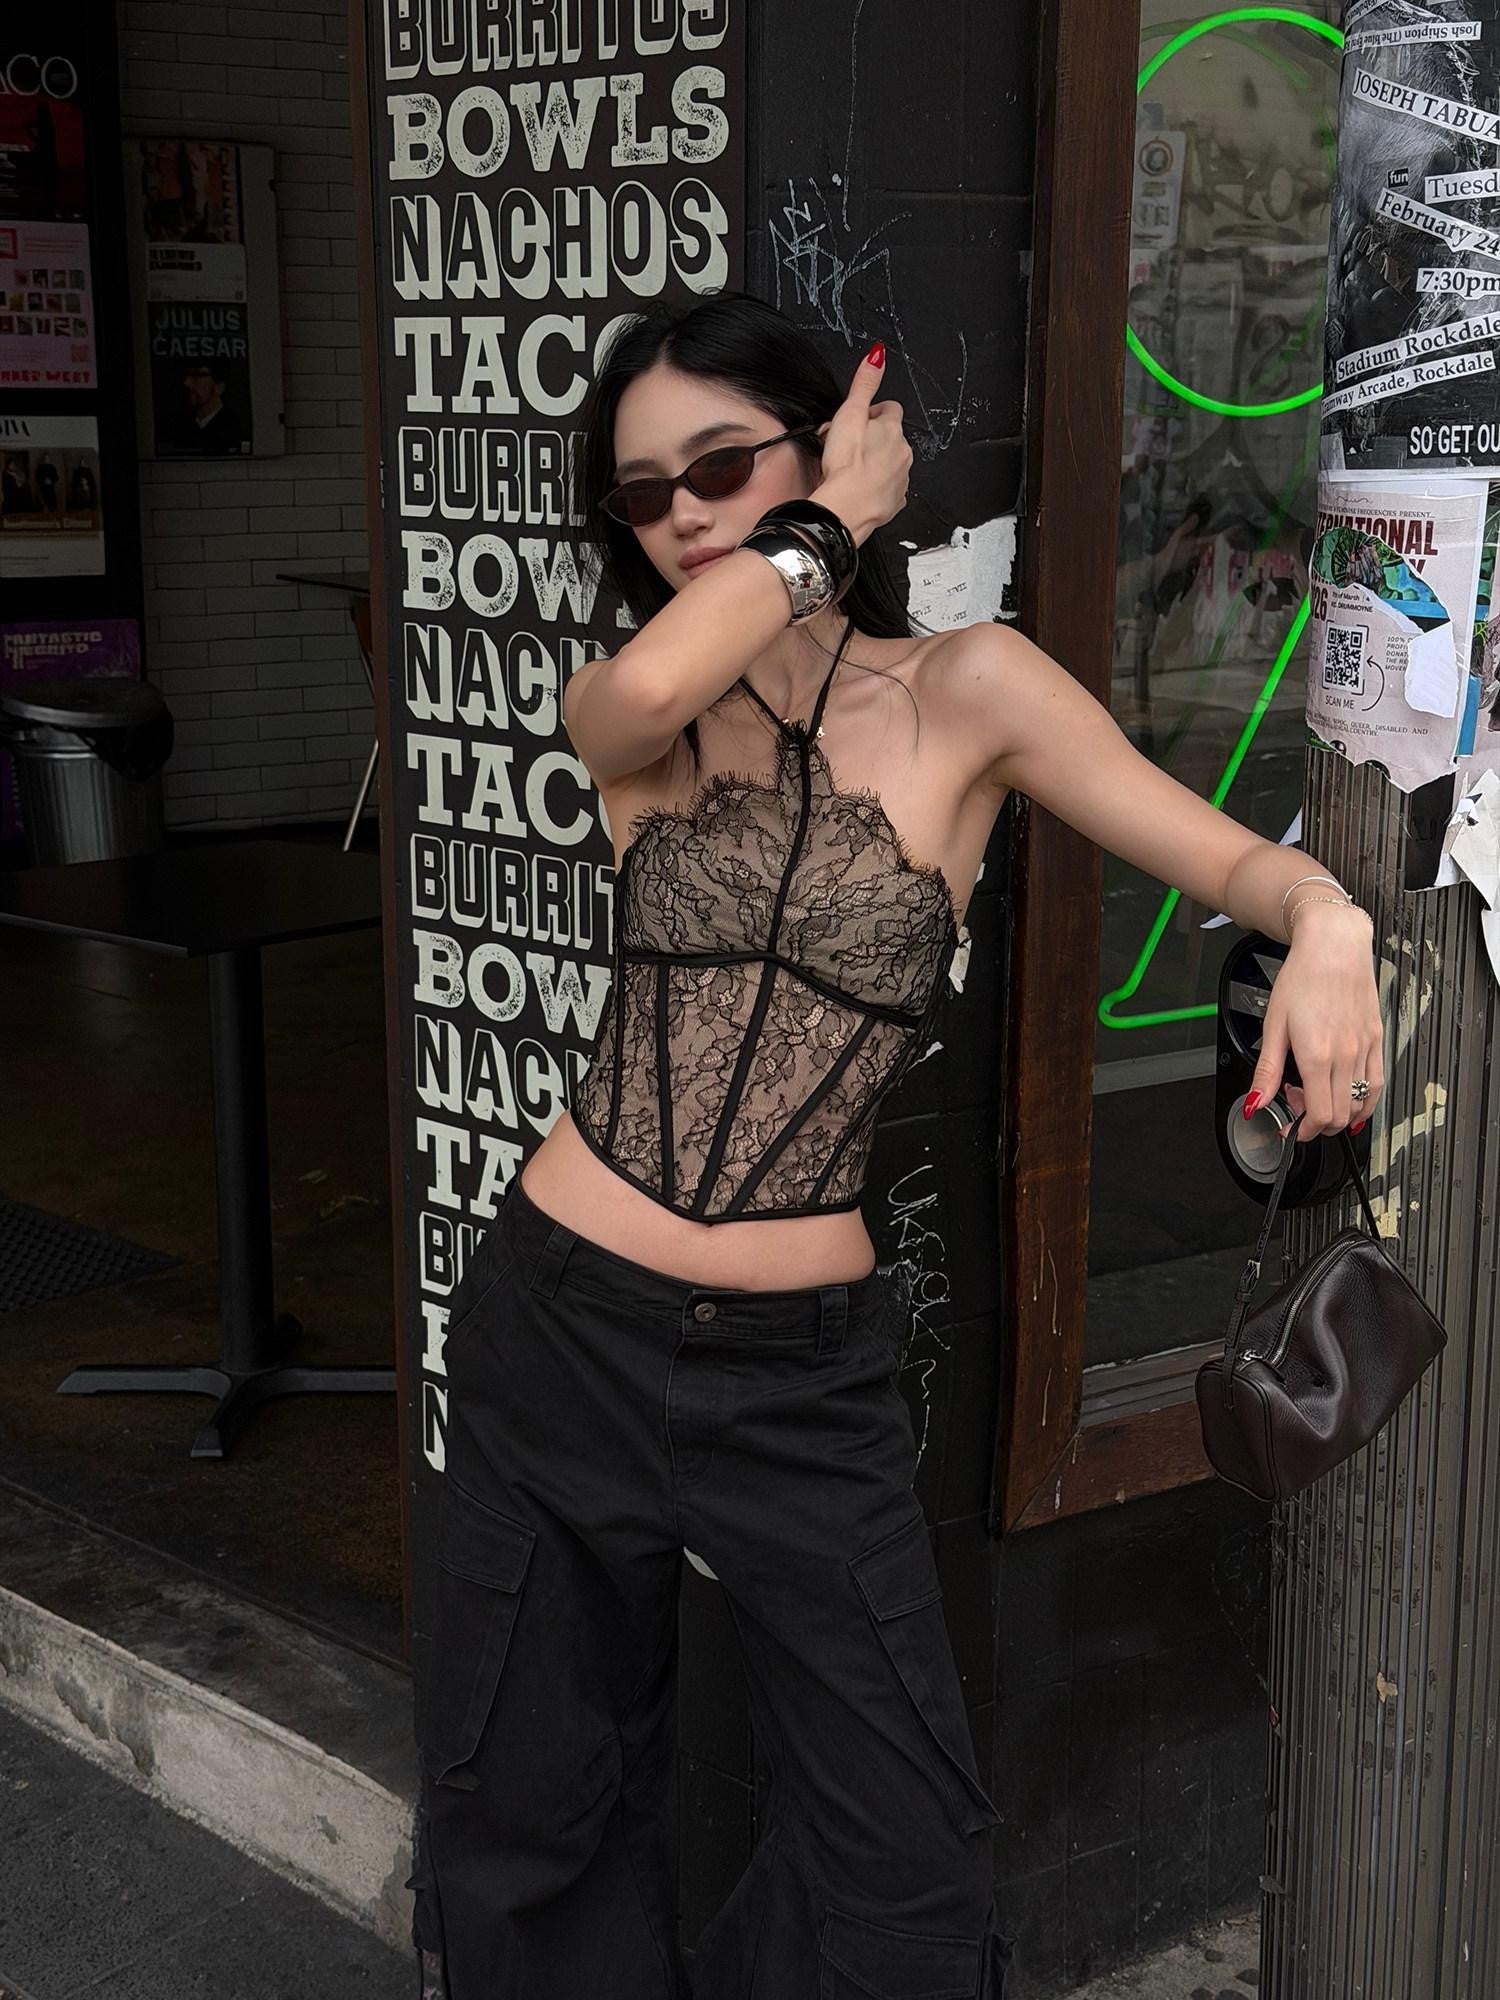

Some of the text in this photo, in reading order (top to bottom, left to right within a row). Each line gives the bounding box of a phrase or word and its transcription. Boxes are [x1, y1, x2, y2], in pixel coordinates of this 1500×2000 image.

[1405, 25, 1448, 41] Shipton
[1451, 24, 1479, 38] Josh
[0, 54, 78, 98] CO
[386, 65, 729, 180] BOWLS
[1354, 71, 1500, 139] JOSEPH TABUA
[1390, 171, 1409, 185] fun
[1428, 172, 1499, 198] Tuesd
[390, 177, 729, 301] NACHOS
[1379, 194, 1500, 256] February 24
[1422, 271, 1500, 297] 7:30pm
[155, 309, 241, 332] JULIUS
[153, 334, 247, 359] CAESAR
[1337, 317, 1500, 380] Stadium Rockdale
[1358, 374, 1409, 399] Arcade,
[1413, 354, 1493, 383] Rockdale
[1410, 423, 1500, 455] SO GET OU
[401, 530, 640, 629] BOW
[1325, 694, 1354, 709] SCAN ME
[406, 732, 613, 846] TAC
[413, 929, 612, 1041] BOW
